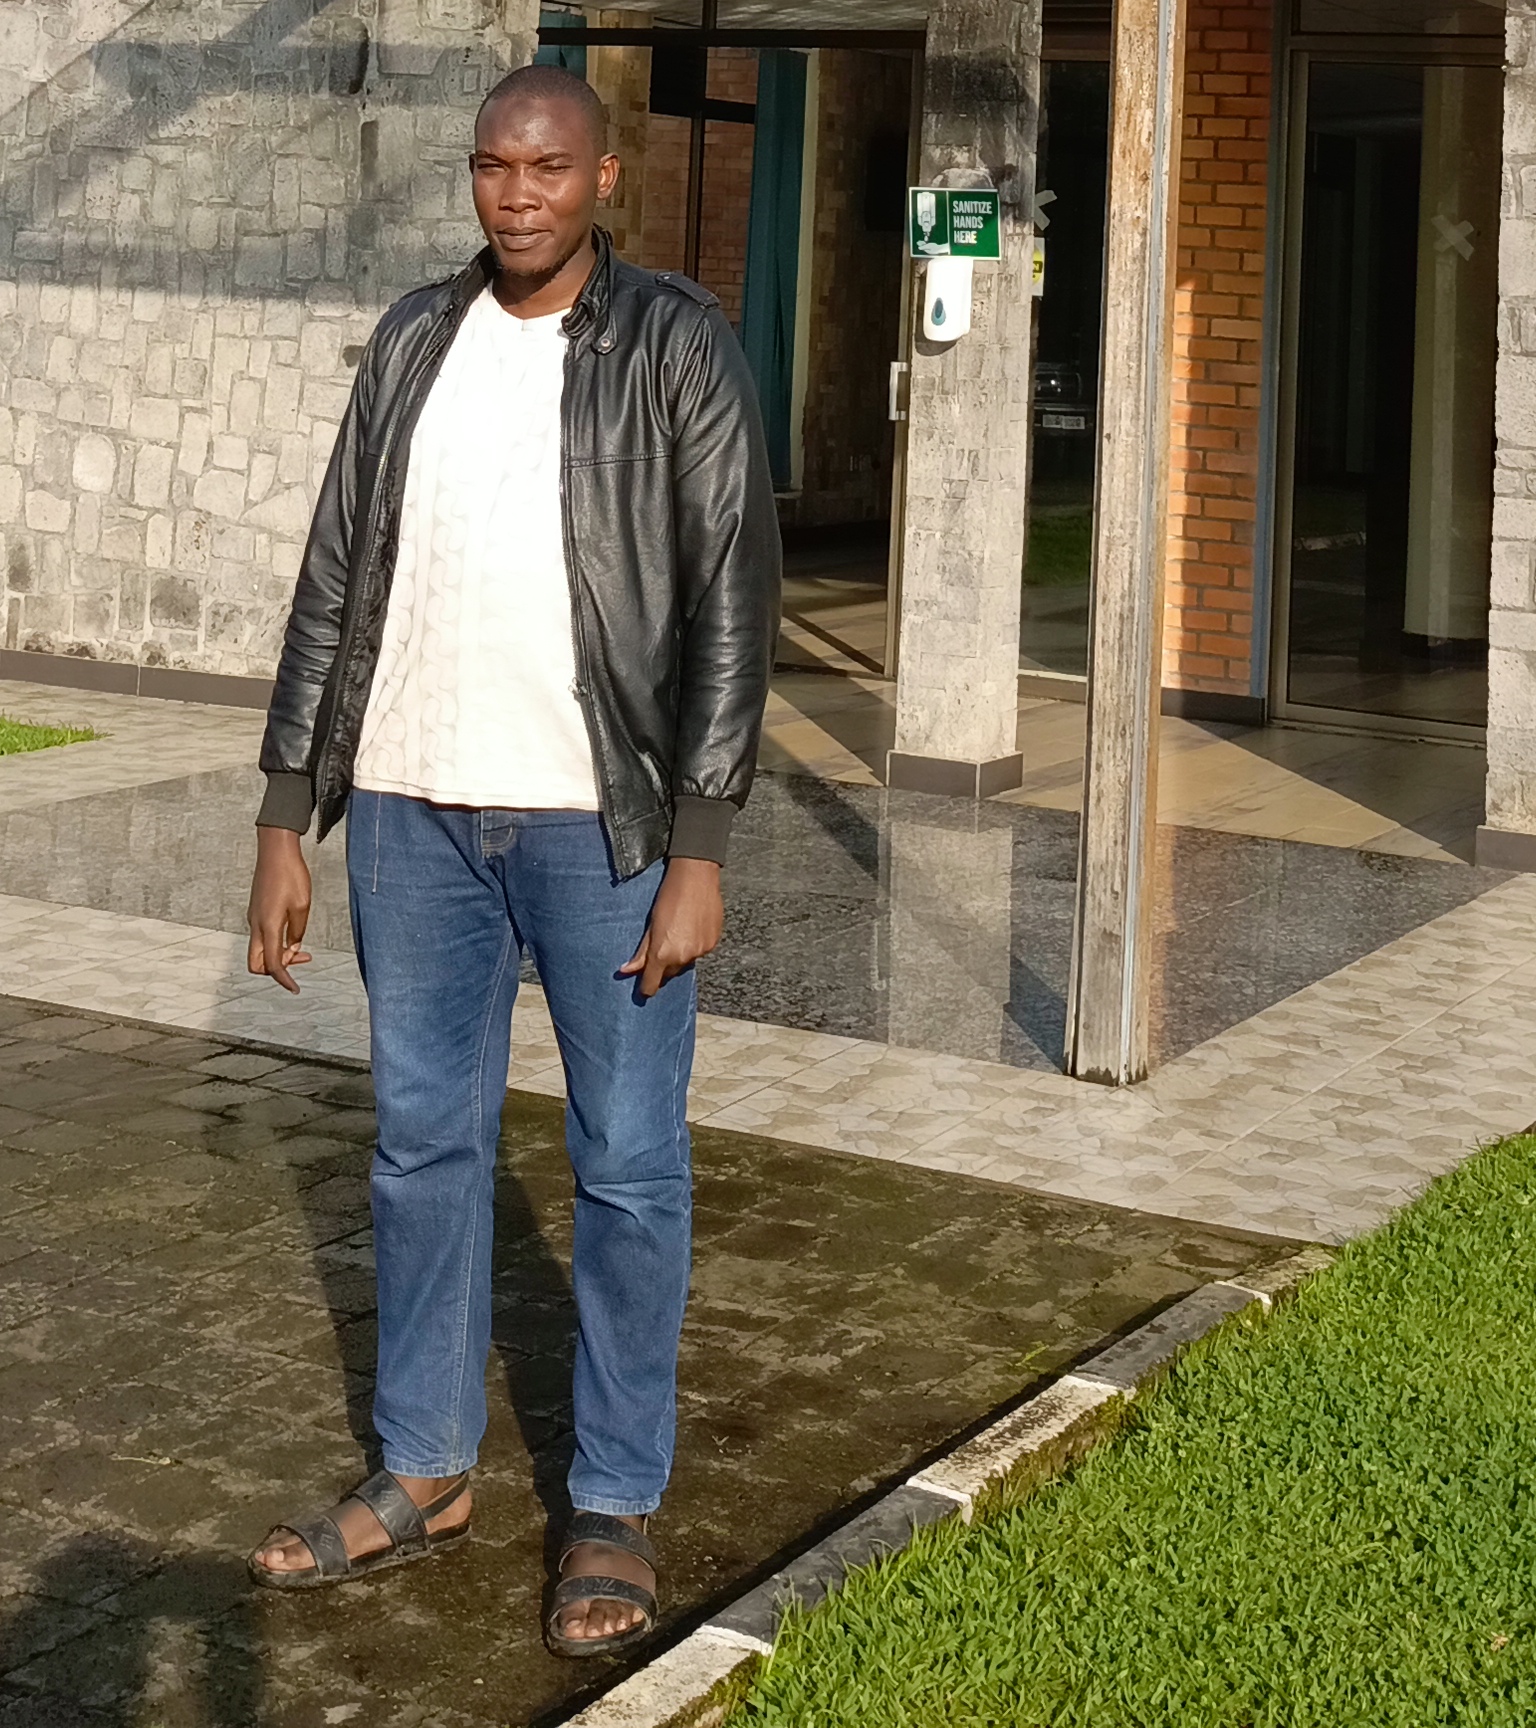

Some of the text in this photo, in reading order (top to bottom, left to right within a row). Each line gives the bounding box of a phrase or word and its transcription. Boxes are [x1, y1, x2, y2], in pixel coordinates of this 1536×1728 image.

[952, 200, 993, 215] SANITIZE
[953, 215, 984, 229] HANDS
[953, 230, 978, 244] HERE
